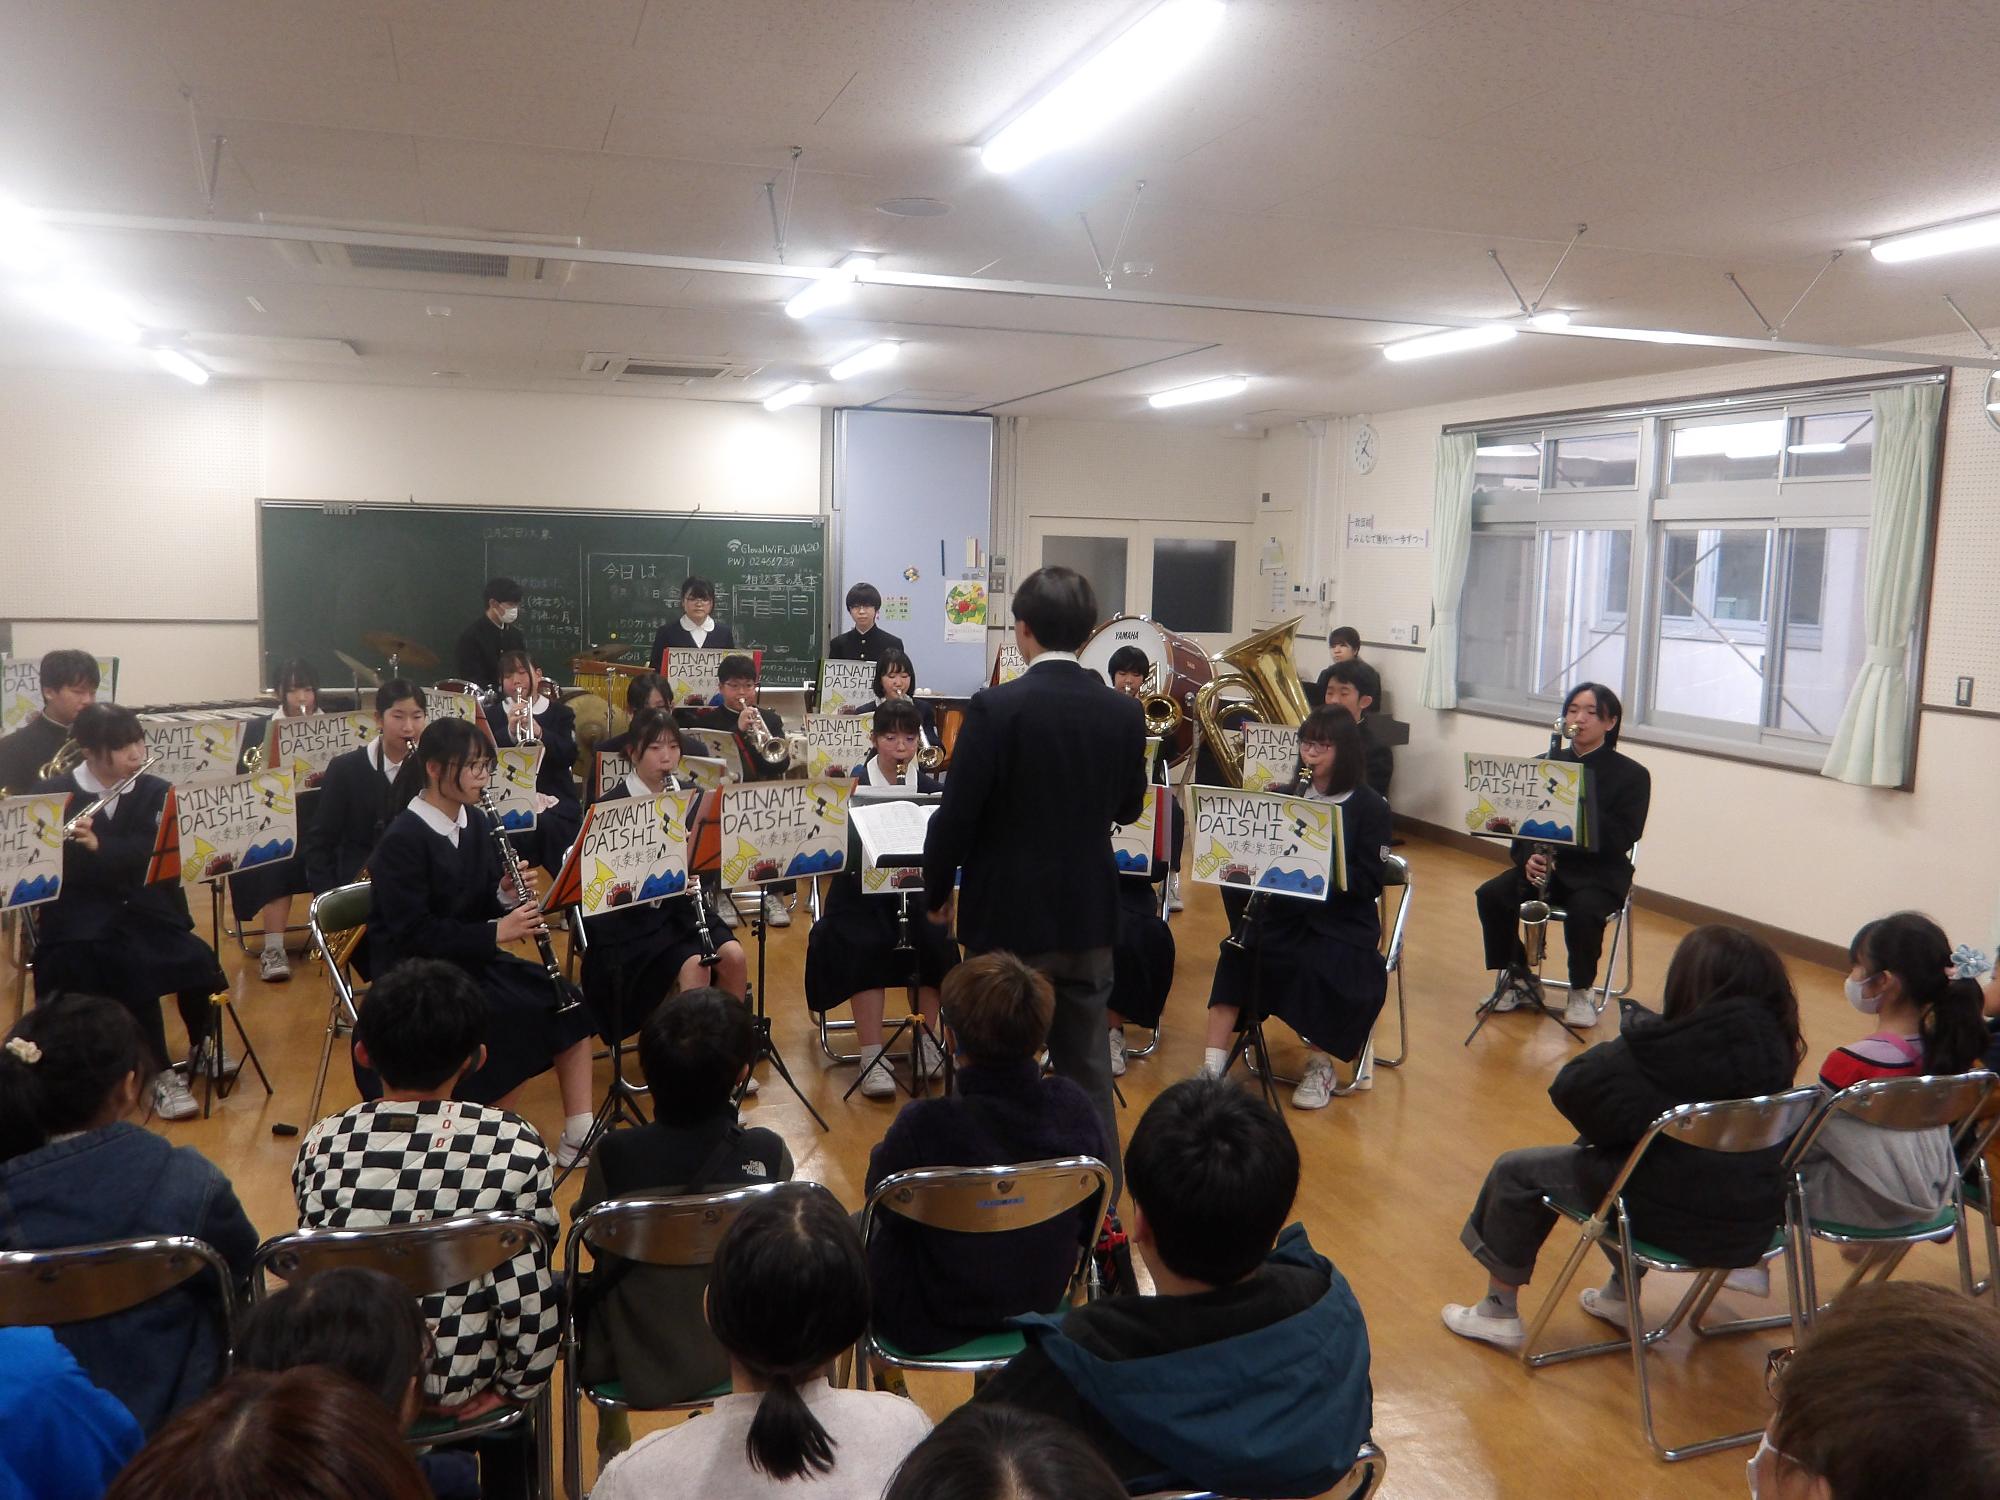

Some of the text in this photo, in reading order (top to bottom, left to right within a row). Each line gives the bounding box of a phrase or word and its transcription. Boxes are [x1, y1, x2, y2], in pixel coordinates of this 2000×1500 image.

[602, 562, 657, 580] 今日は
[1114, 631, 1139, 641] YAMAHA
[669, 652, 722, 666] MINAMI
[824, 663, 877, 678] MINAMI
[824, 677, 875, 689] DAISHI
[279, 716, 351, 741] MINAMI
[807, 718, 863, 733] MINAMI
[143, 727, 195, 744] NAMI
[280, 732, 352, 756] DAISHI
[808, 733, 864, 747] DAISHI
[1246, 728, 1300, 746] MINAM
[145, 744, 196, 761] ISHI
[1246, 745, 1300, 761] DAISH
[1469, 760, 1538, 781] MINAMI
[1469, 777, 1539, 797] DAISHI
[176, 780, 256, 815] MINAMI
[722, 785, 807, 814] MINAMI
[587, 799, 656, 835] MINAMI
[1198, 795, 1284, 822] MINAMI
[180, 801, 259, 836] DAISHI
[723, 807, 807, 835] DAISHI
[1199, 814, 1285, 841] DAISHI
[584, 824, 658, 857] DAISHI
[1227, 840, 1284, 856] 吹奏楽部
